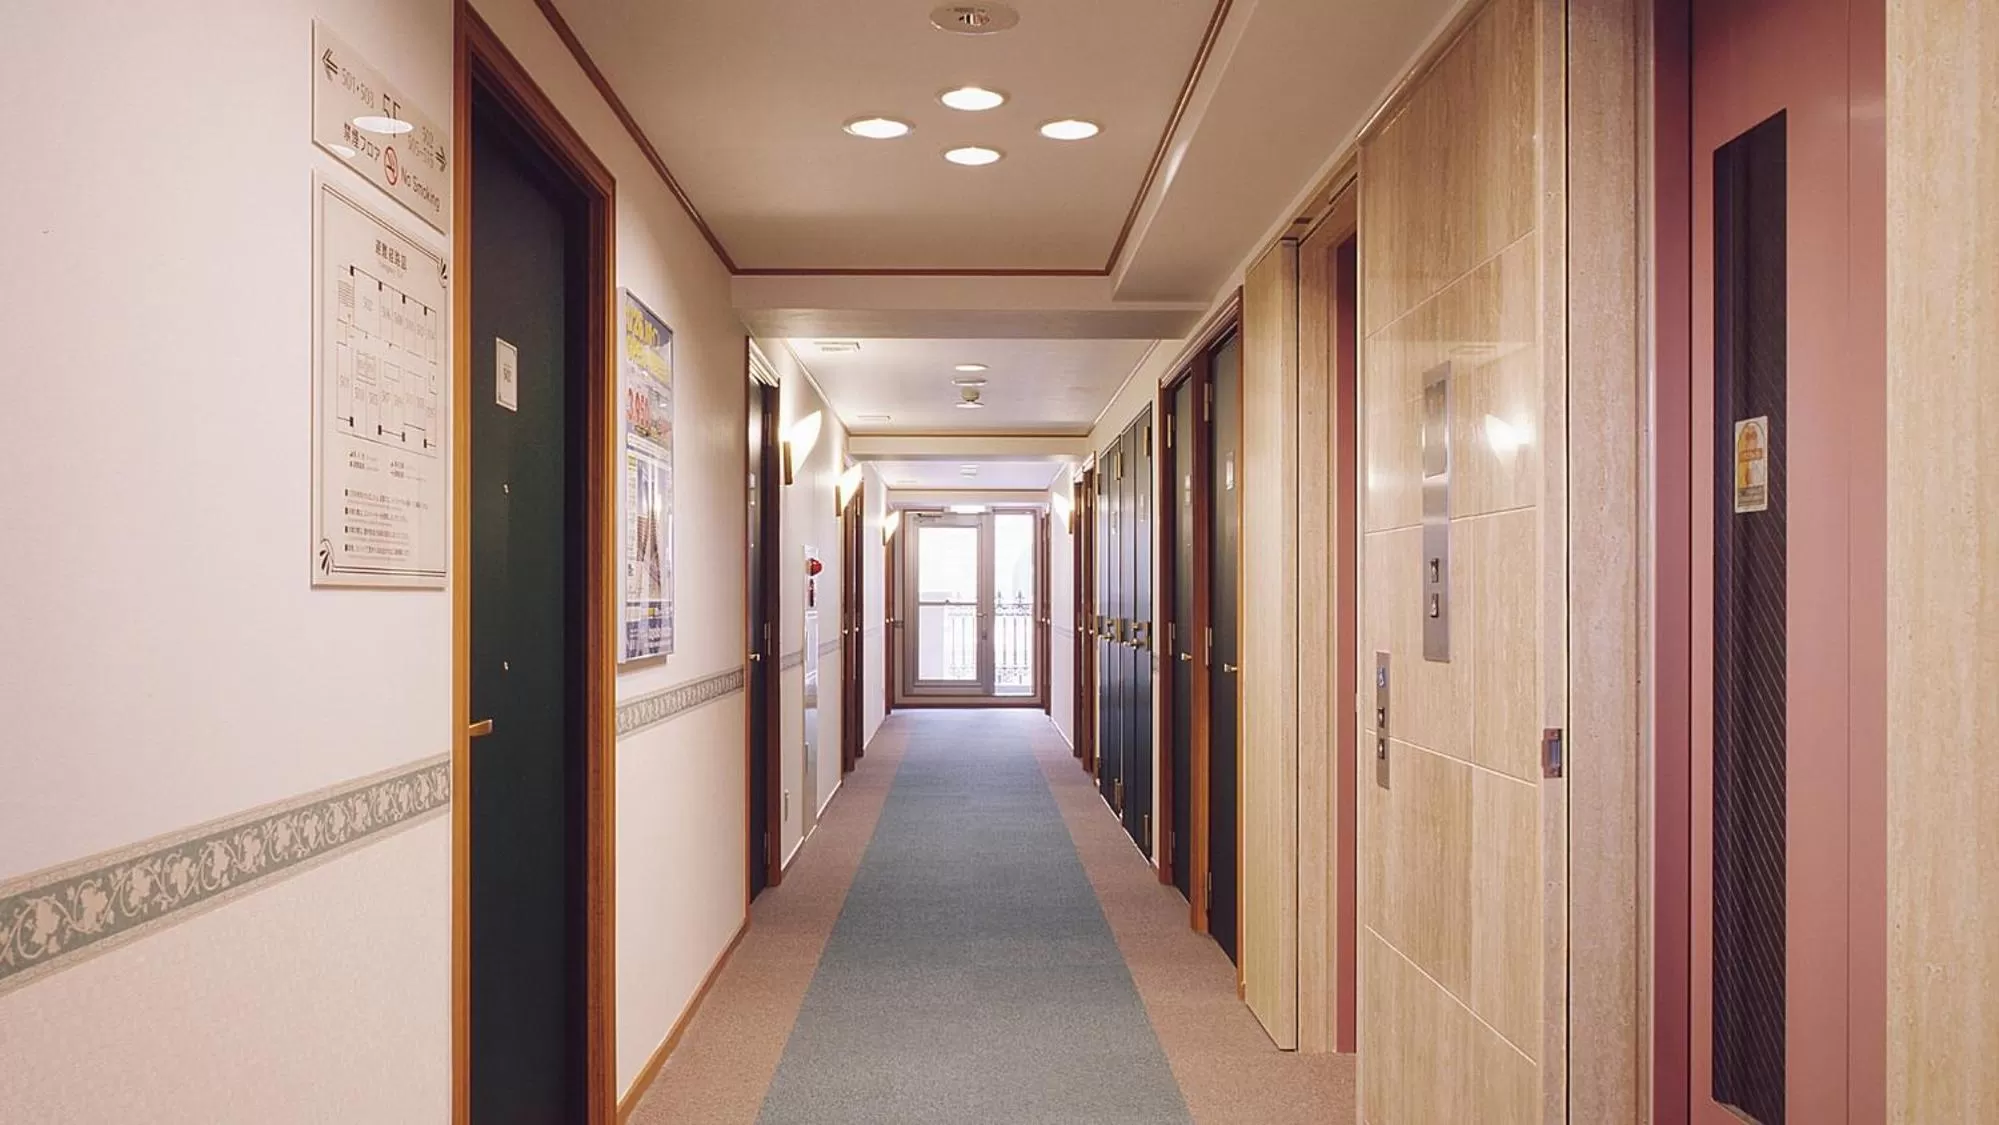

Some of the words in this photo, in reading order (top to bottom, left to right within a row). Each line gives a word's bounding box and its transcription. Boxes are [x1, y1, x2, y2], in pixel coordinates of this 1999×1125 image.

[343, 120, 380, 162] 禁煙フロア
[401, 165, 411, 188] No
[413, 175, 440, 213] Smoking
